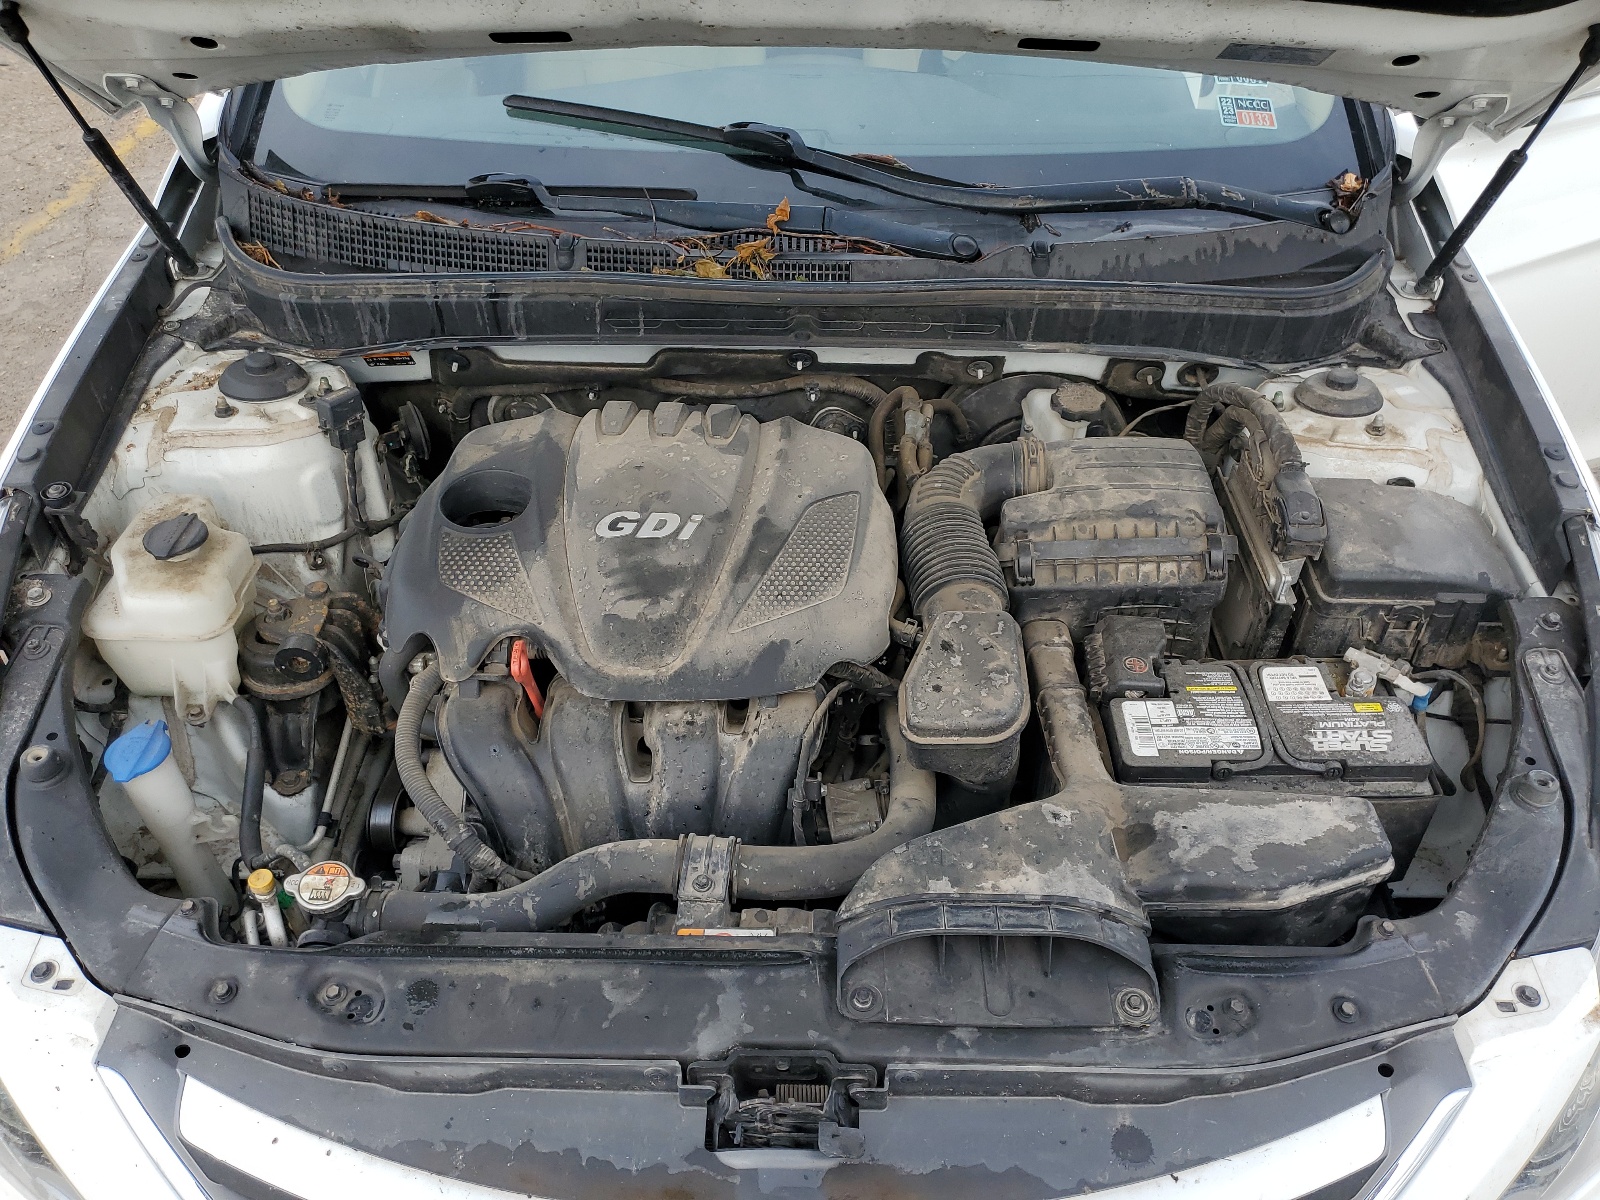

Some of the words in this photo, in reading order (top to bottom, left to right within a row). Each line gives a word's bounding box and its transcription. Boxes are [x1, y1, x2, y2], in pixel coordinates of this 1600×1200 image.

[1221, 98, 1232, 106] 22
[1237, 100, 1268, 109] NCCC
[1223, 107, 1234, 115] 23
[1242, 111, 1270, 126] 0133
[595, 510, 704, 540] GDi
[1319, 720, 1386, 728] PLATINUM
[1310, 730, 1393, 743] START
[1312, 740, 1388, 752] SUPER
